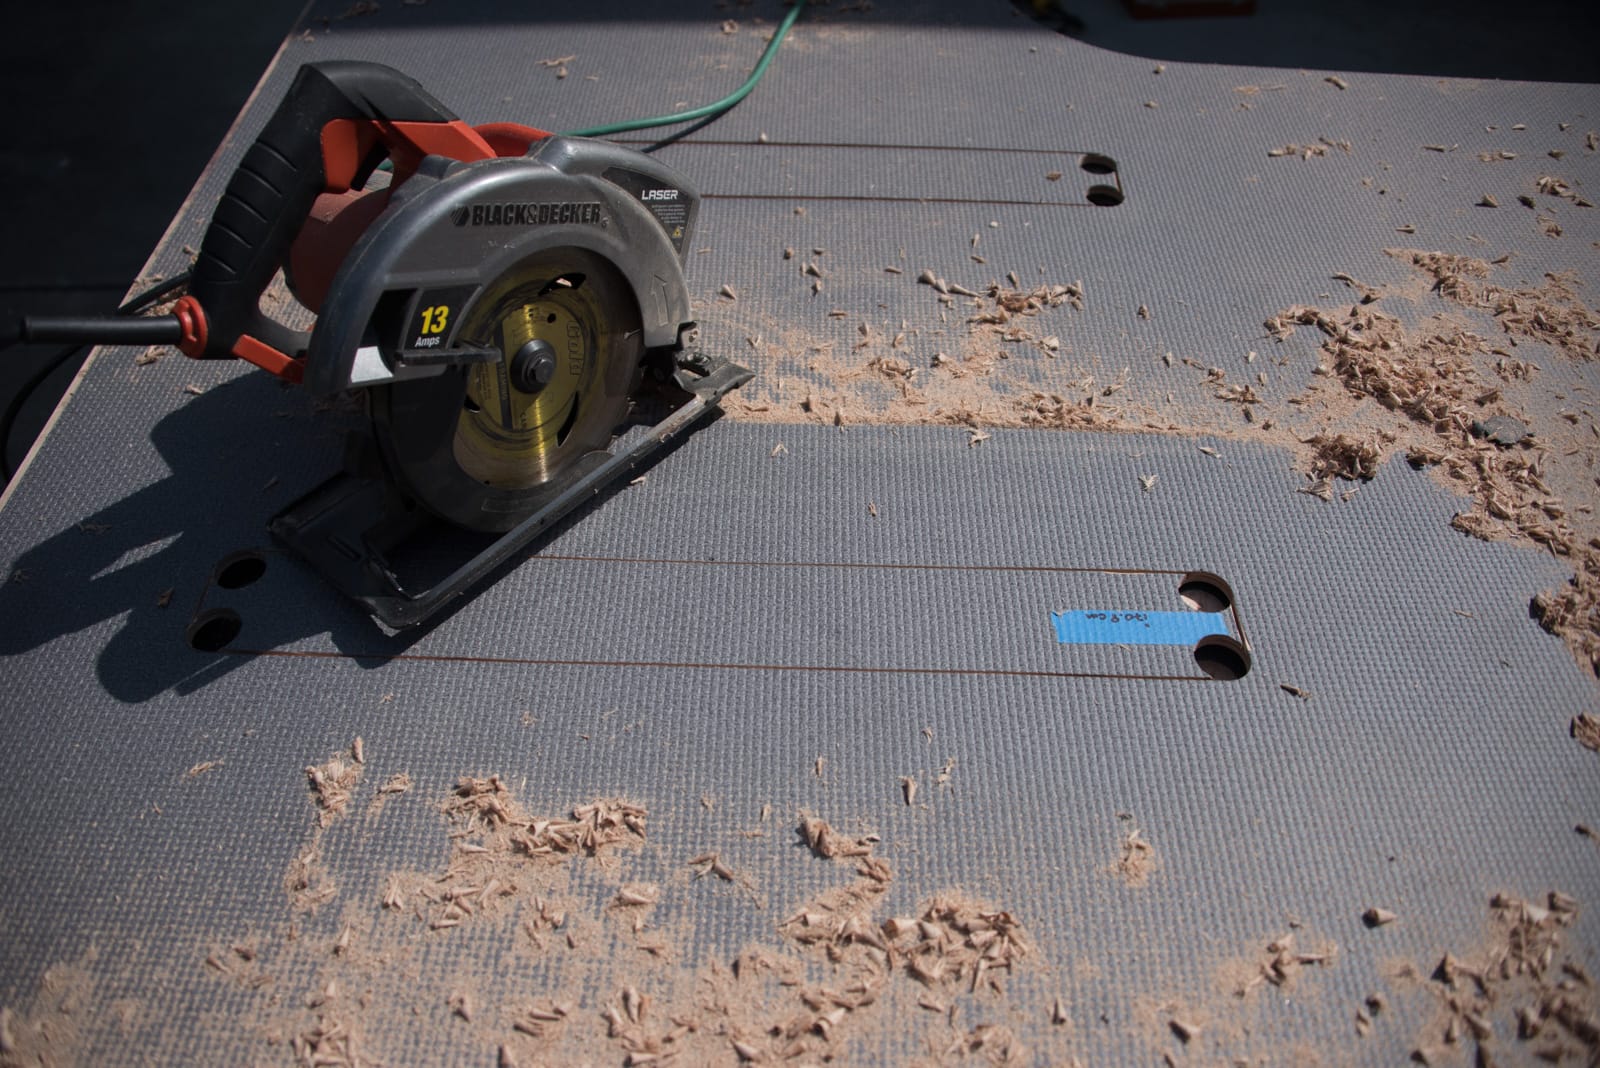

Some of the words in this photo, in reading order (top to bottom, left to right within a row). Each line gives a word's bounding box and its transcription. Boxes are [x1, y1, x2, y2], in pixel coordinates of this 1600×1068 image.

[641, 189, 679, 201] LASER
[471, 202, 601, 226] BLACK&DECKER
[421, 305, 449, 335] 13
[414, 336, 440, 348] Amps
